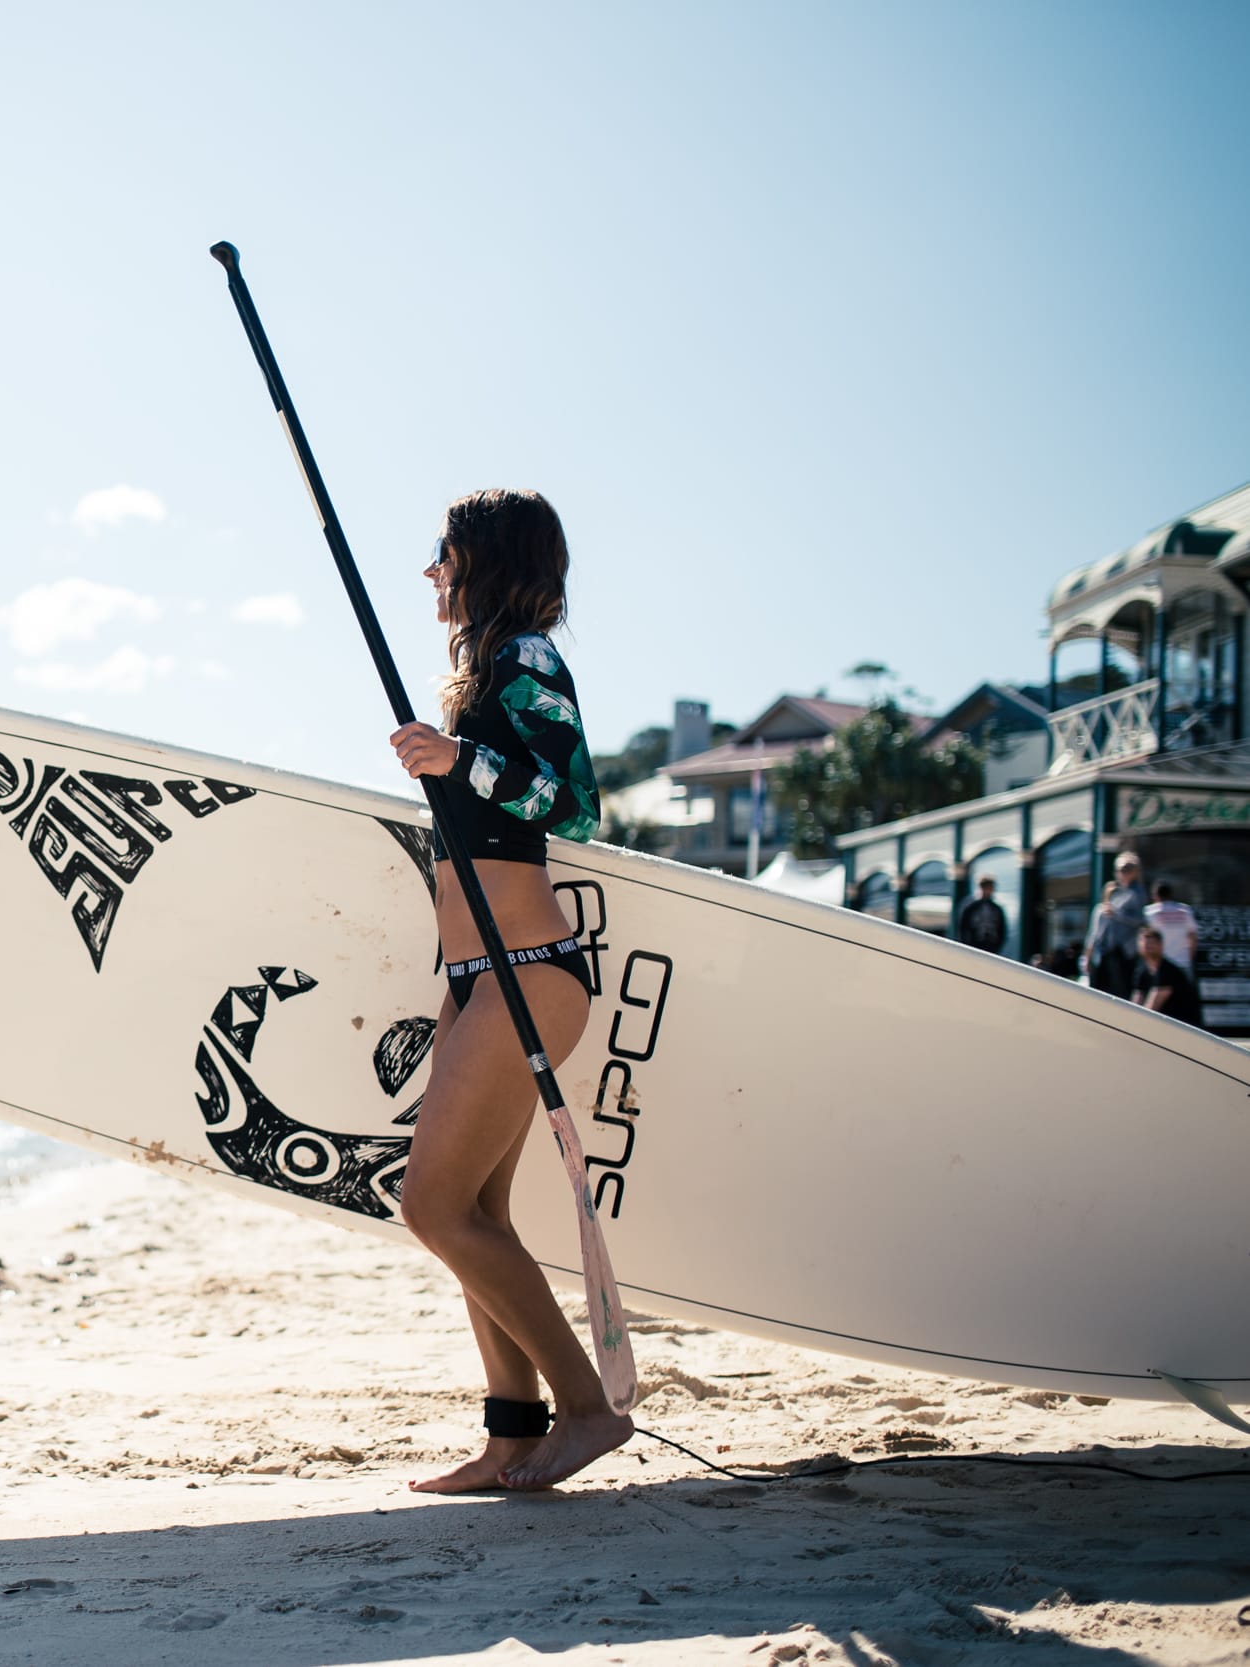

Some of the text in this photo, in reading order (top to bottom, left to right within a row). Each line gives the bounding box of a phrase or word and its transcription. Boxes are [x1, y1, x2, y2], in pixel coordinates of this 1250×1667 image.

[468, 956, 493, 974] BONDS
[507, 946, 552, 964] BONDS
[585, 950, 673, 1219] SUPCO
